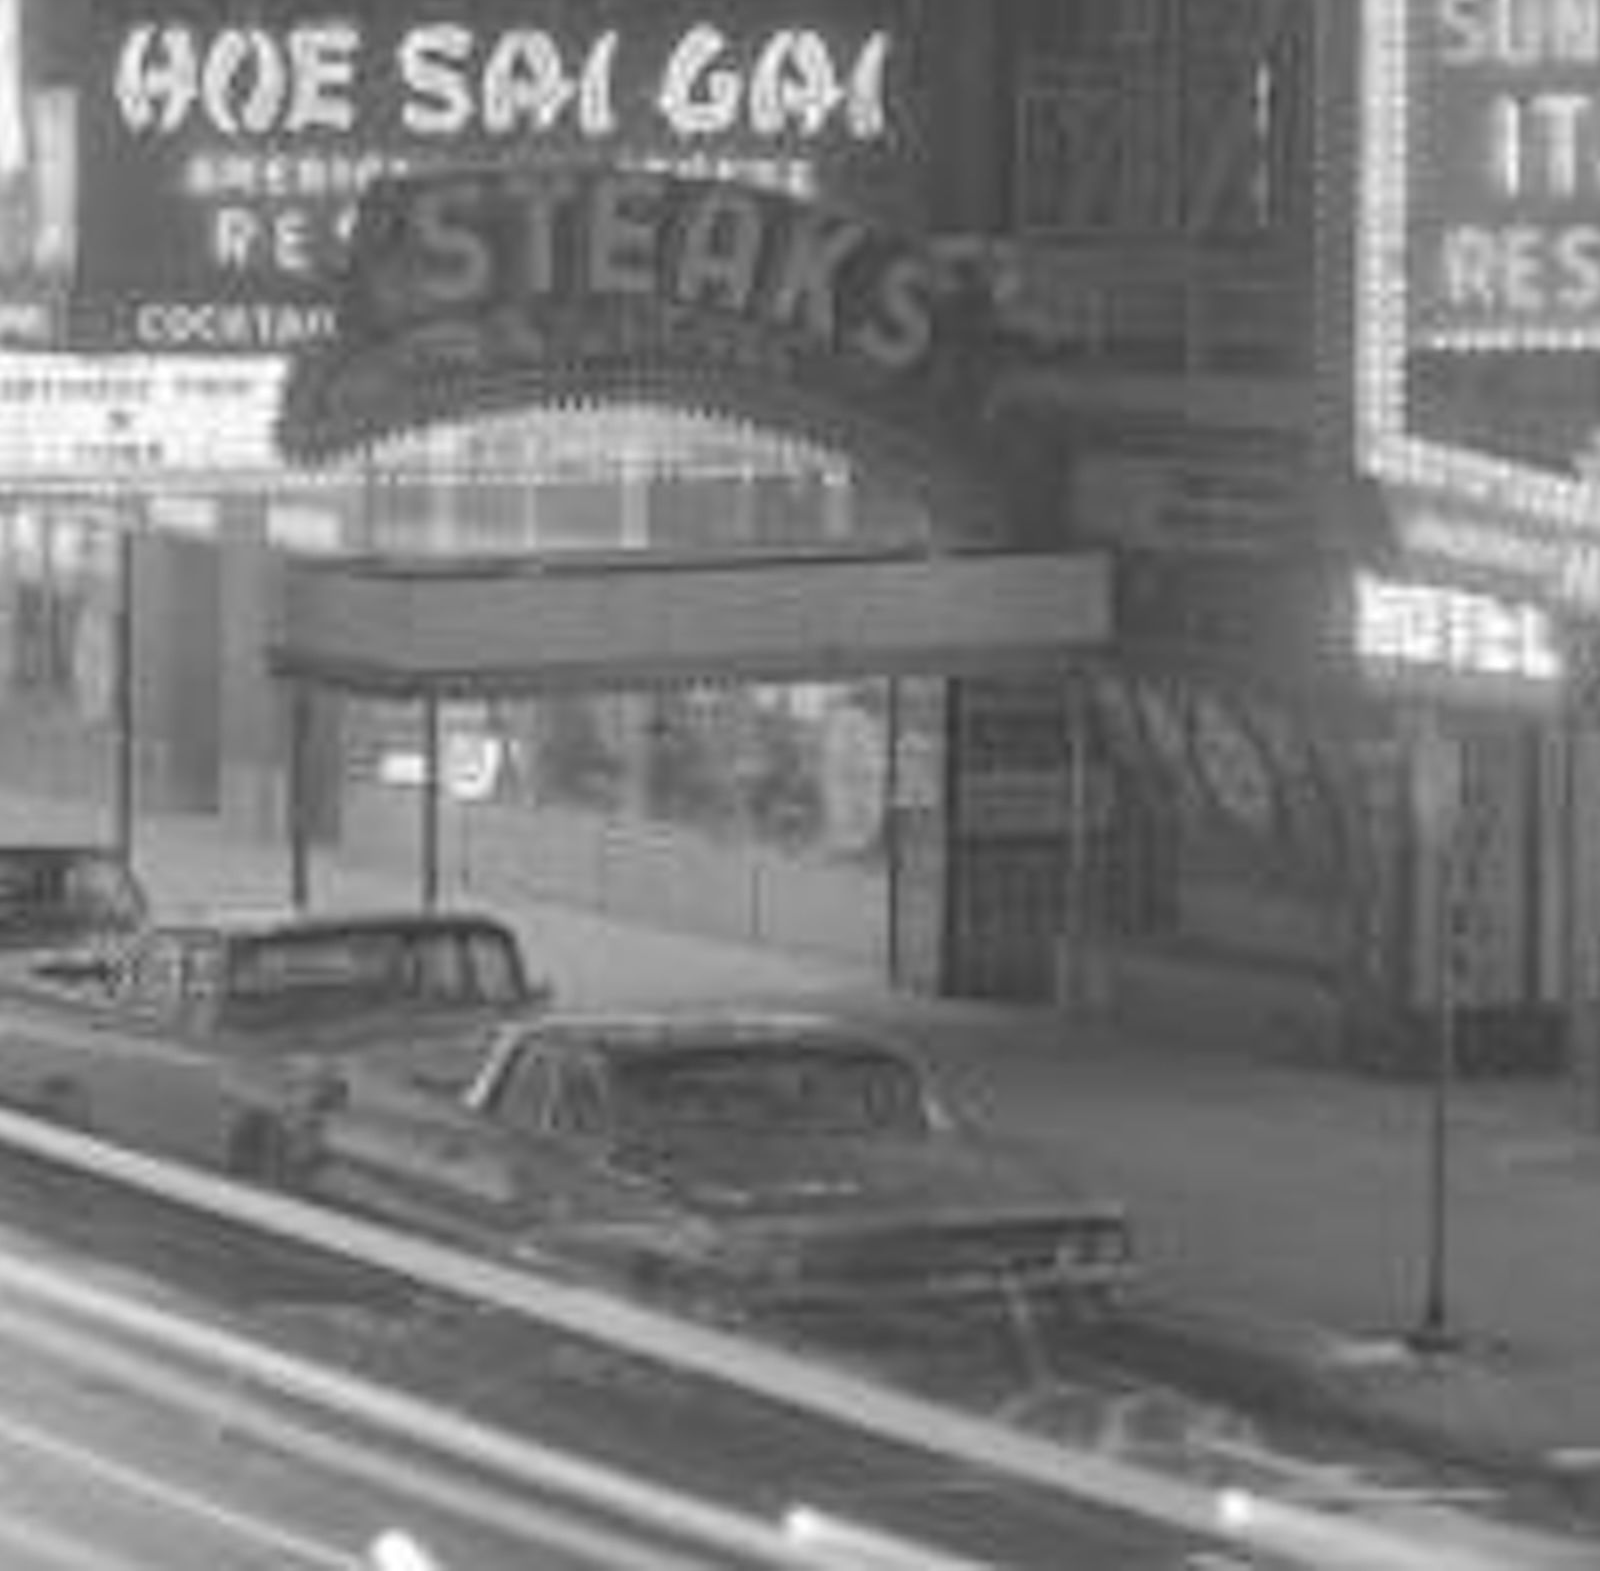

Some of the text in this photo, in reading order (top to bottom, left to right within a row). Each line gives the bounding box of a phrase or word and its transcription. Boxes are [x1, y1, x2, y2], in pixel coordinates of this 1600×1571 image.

[112, 20, 890, 138] HOE SAI GAI
[407, 174, 935, 369] STEAKS
